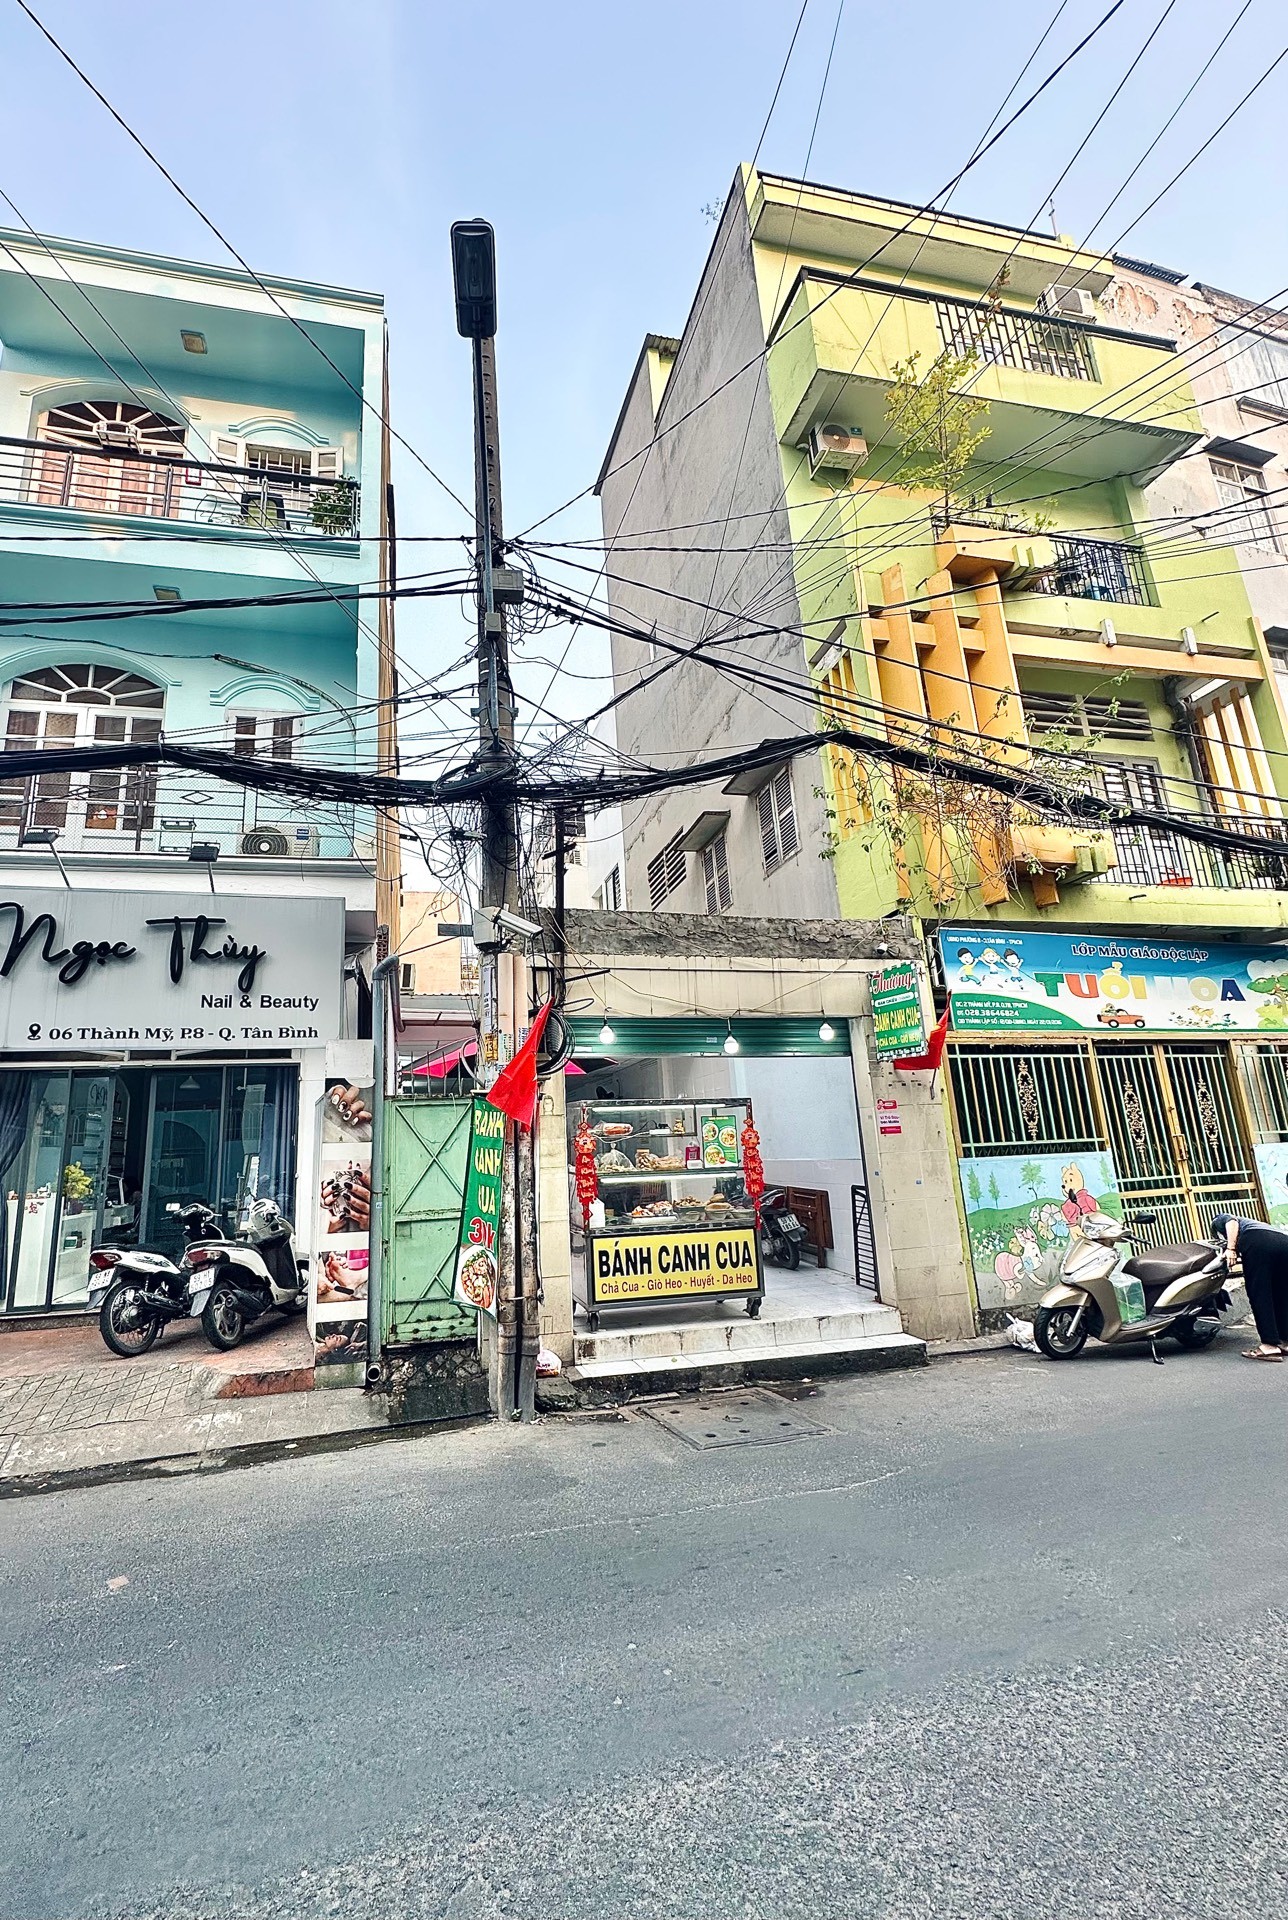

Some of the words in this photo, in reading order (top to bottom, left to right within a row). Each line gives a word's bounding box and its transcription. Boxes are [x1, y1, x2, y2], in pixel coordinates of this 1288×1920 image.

[0, 901, 137, 985] Ngọc
[145, 914, 267, 993] Thùy
[1071, 942, 1096, 956] LỚP
[1098, 941, 1127, 957] MẪU
[1129, 946, 1159, 959] GIÁO
[1160, 947, 1187, 962] ĐỘC
[1188, 949, 1209, 963] LẬP
[1033, 962, 1147, 999] TUỔI
[1153, 975, 1247, 1002] HOA
[201, 994, 233, 1009] Nail
[239, 994, 252, 1009] &
[260, 994, 319, 1012] Beauty
[49, 1027, 73, 1040] 06
[77, 1026, 139, 1040] Thành
[144, 1026, 174, 1042] Mỹ,
[180, 1027, 205, 1039] P.8
[218, 1027, 236, 1040] Q.
[240, 1026, 273, 1039] Tân
[278, 1026, 319, 1039] Bình
[598, 1241, 652, 1278] BÁNH
[658, 1243, 711, 1274] CANH
[715, 1240, 754, 1270] CUA
[601, 1280, 619, 1294] Chả
[621, 1281, 639, 1292] Cua
[647, 1278, 663, 1291] Giò
[665, 1278, 683, 1289] Heo
[690, 1273, 715, 1290] Huyết
[722, 1274, 734, 1285] Da
[736, 1273, 753, 1284] Heo
